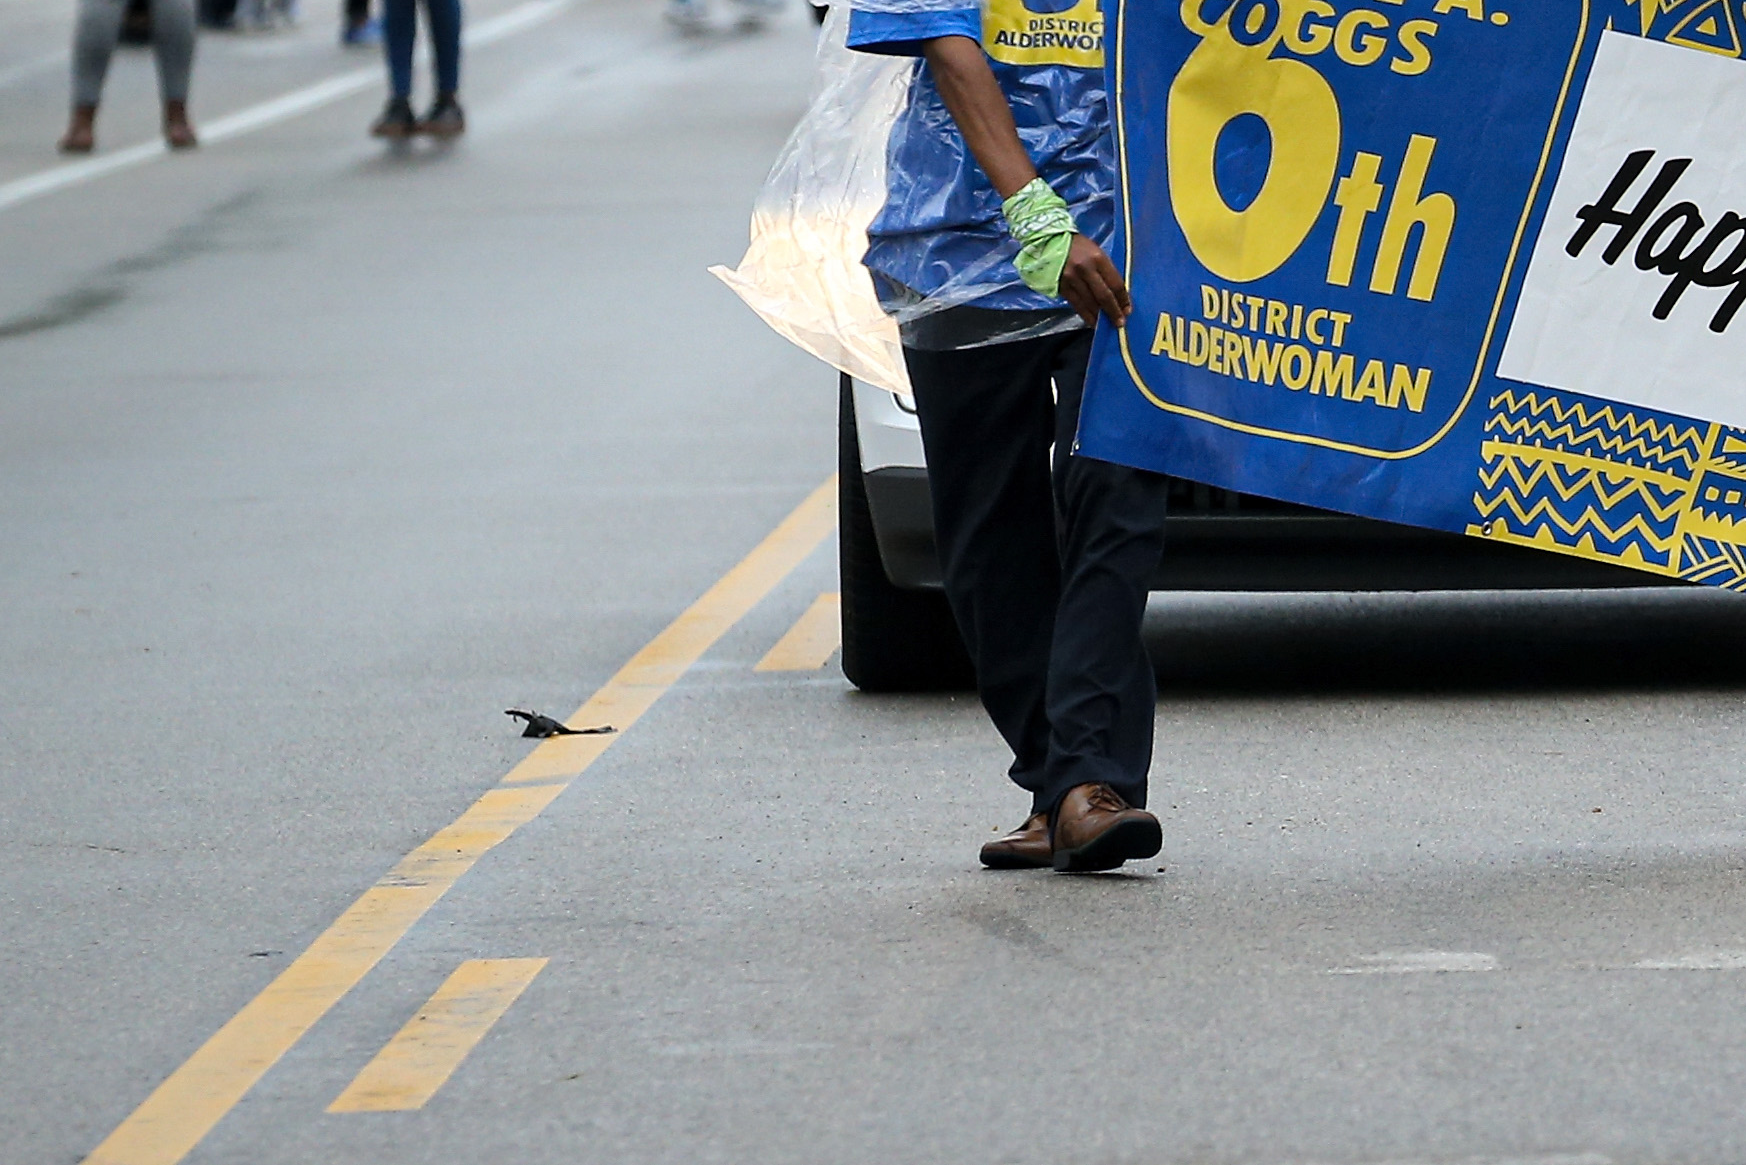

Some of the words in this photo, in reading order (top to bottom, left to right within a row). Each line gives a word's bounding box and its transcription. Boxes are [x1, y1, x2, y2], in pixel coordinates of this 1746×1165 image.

[1167, 21, 1456, 302] 6th
[1150, 311, 1433, 413] ALDERWOMAN
[1200, 283, 1353, 348] DISTRICT
